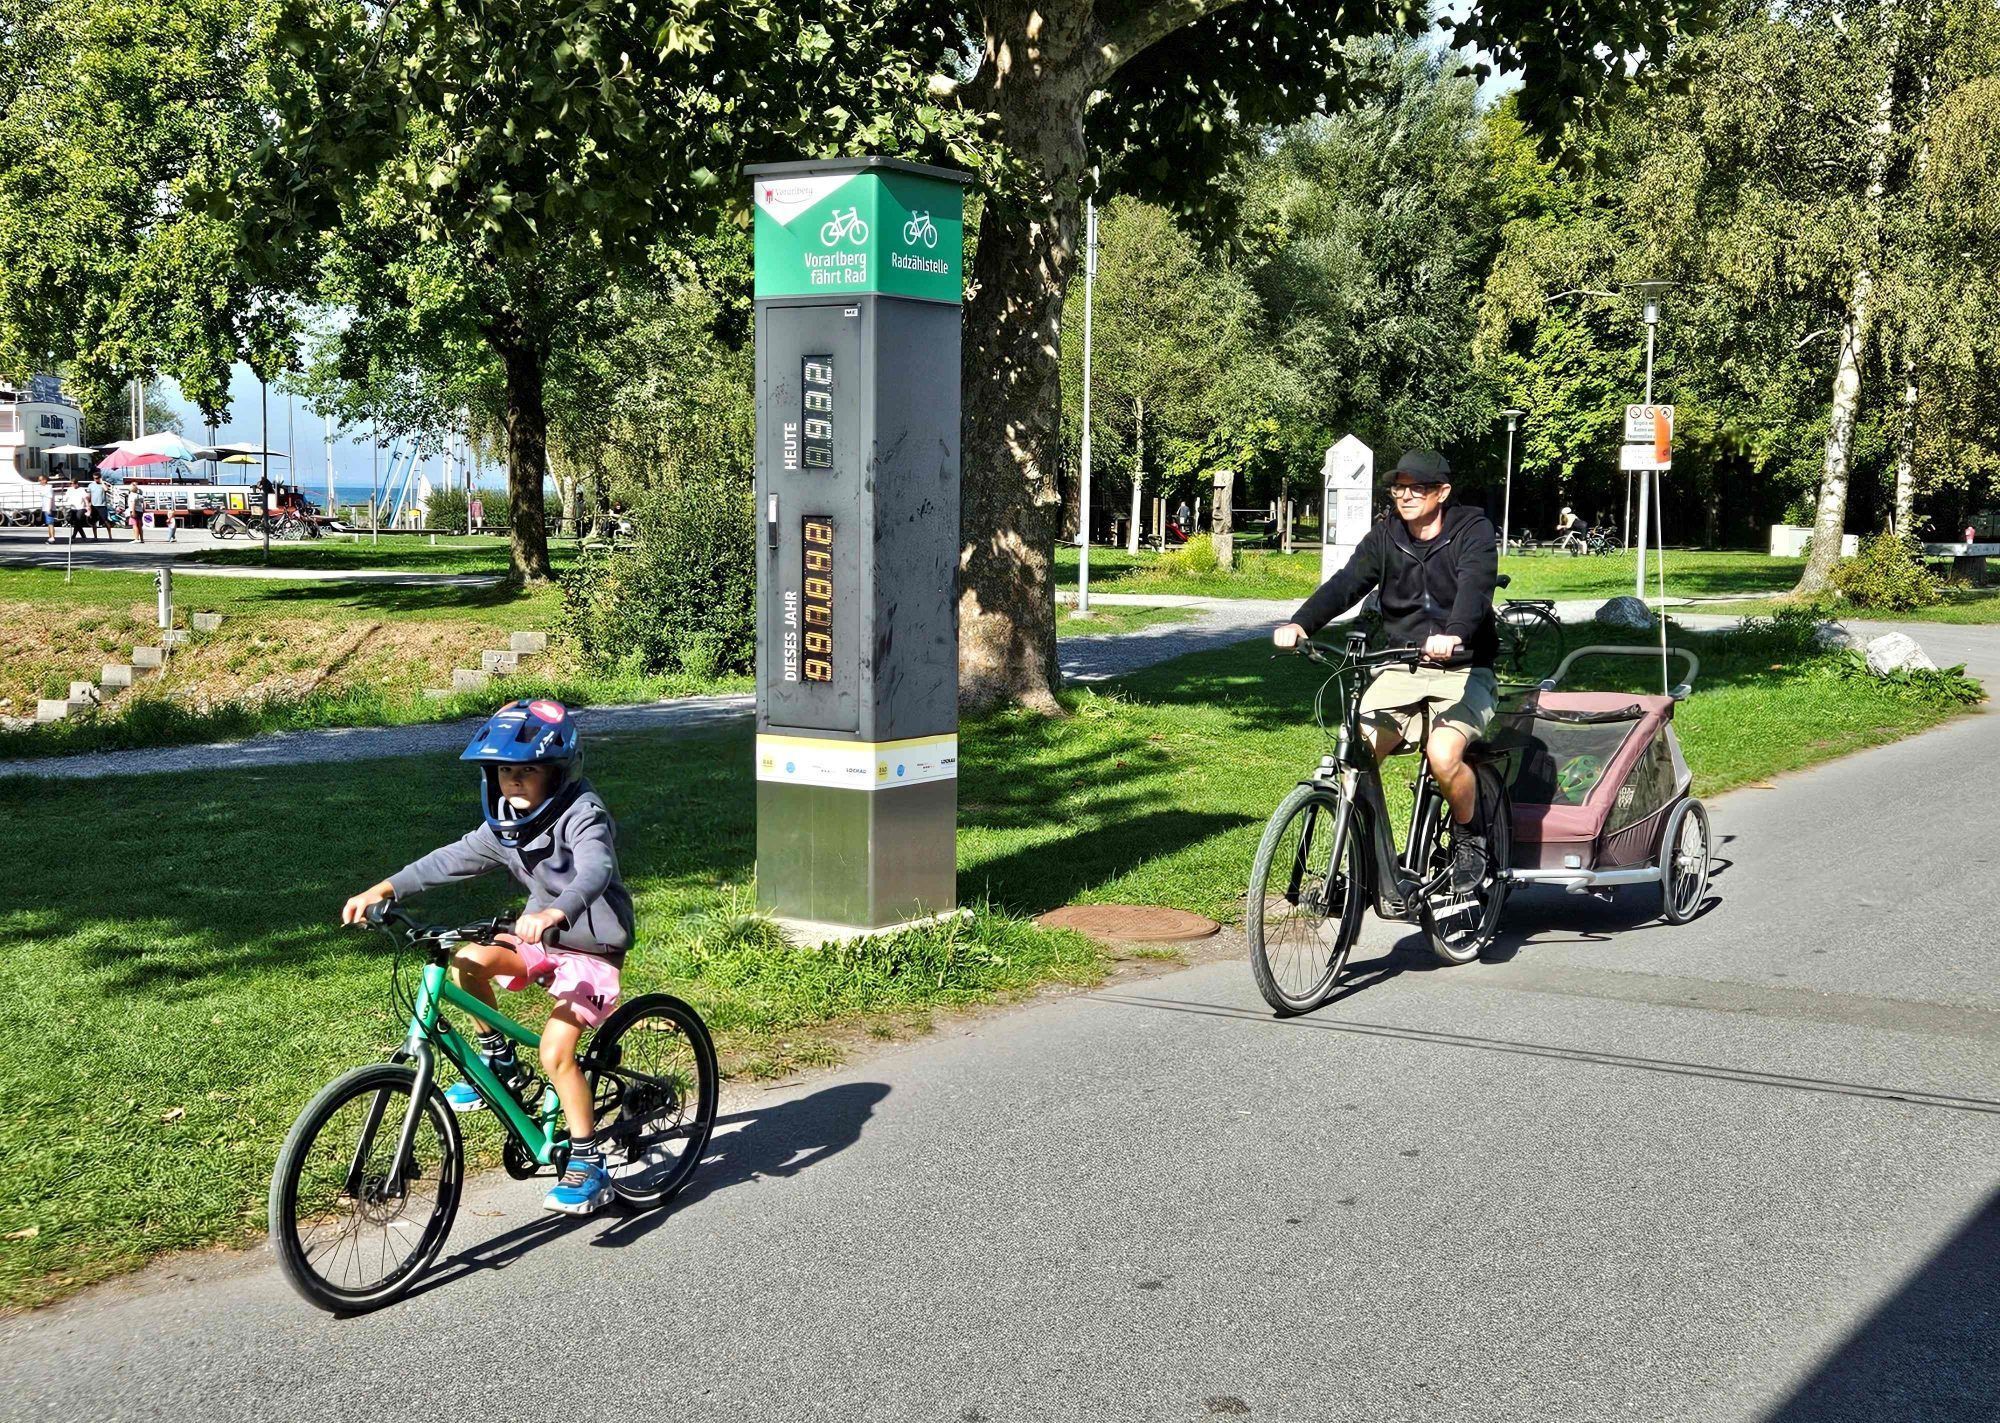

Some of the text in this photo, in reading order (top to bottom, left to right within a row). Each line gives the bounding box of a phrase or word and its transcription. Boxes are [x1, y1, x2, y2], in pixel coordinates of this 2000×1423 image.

[804, 251, 867, 269] Vorarlberg
[891, 252, 949, 275] Radzählstelle
[810, 268, 867, 285] fährt Rad
[784, 422, 797, 470] HEUTE
[784, 590, 797, 681] DIESES JAHR
